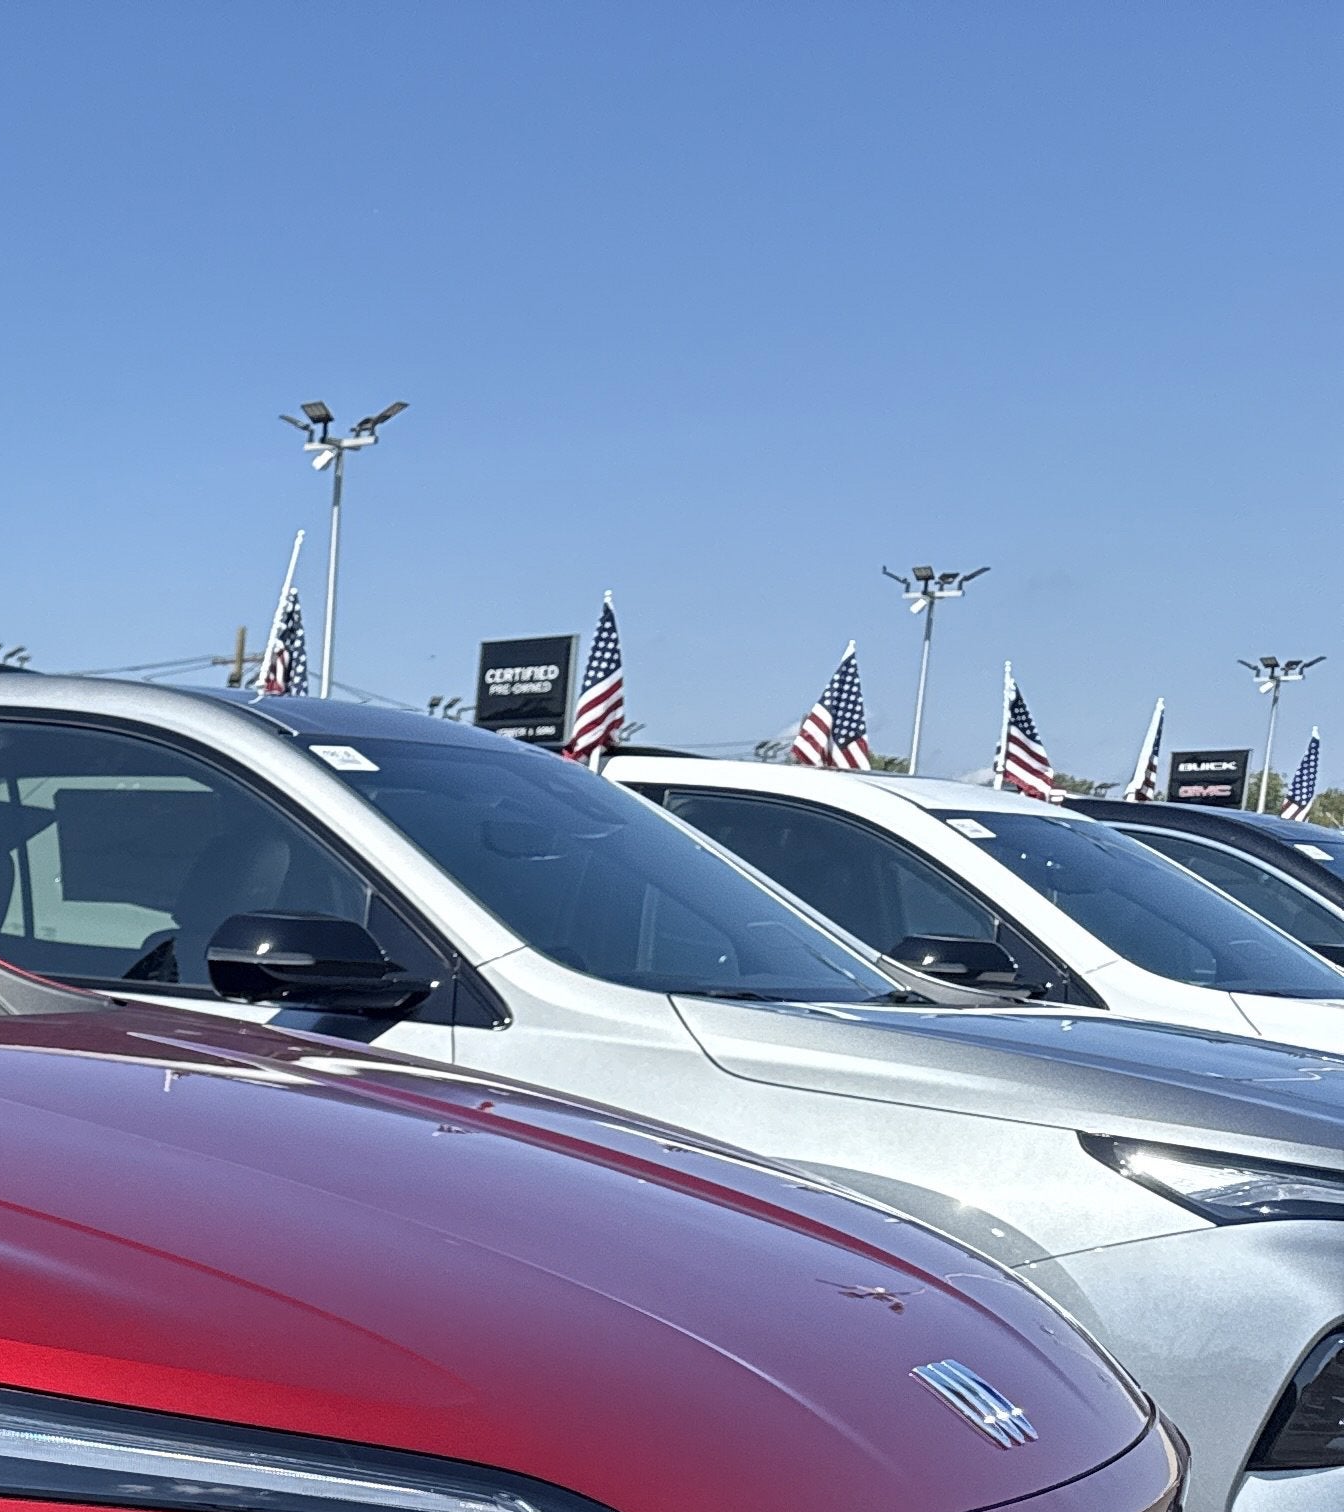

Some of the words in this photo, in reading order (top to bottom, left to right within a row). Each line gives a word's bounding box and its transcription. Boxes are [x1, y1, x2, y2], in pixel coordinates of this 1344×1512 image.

[484, 664, 560, 684] CERTIFIED
[1178, 761, 1238, 772] BUICK
[1179, 784, 1233, 798] GMC
